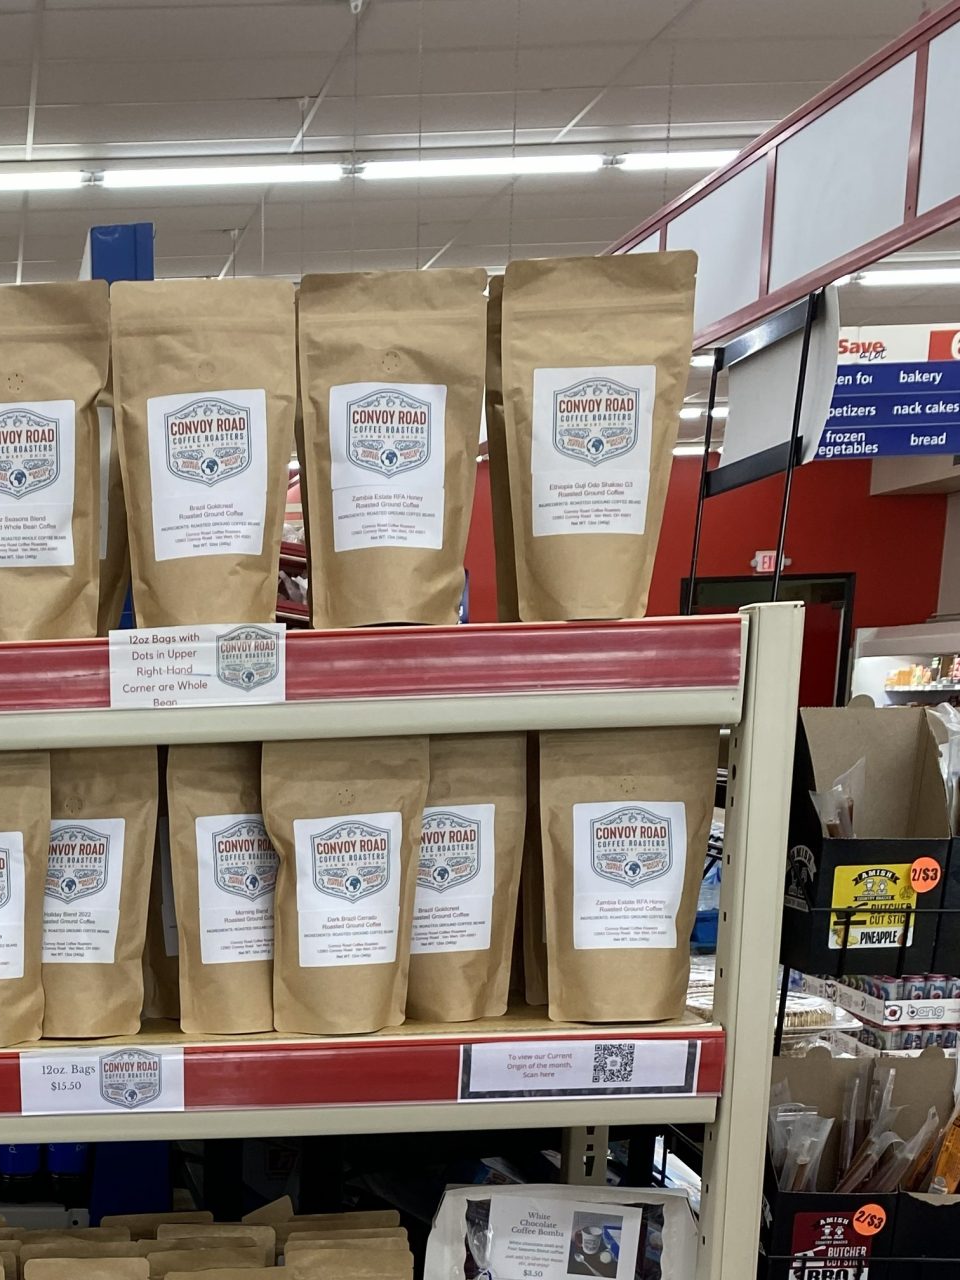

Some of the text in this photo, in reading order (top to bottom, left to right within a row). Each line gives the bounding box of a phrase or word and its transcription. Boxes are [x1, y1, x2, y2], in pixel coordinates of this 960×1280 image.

[838, 339, 884, 354] Save
[899, 370, 943, 385] bakery
[558, 398, 634, 414] CONVOY ROAD
[829, 404, 876, 417] petizers
[893, 401, 960, 415] nack cakes
[560, 412, 632, 423] COFFEE ROASTERS
[26, 428, 55, 444] ROAD
[826, 430, 866, 443] frozen
[910, 432, 947, 446] bread
[14, 444, 53, 454] ROASTERS
[818, 442, 879, 458] egetables
[129, 632, 200, 646] 12oz Bags with
[132, 649, 198, 662] Dots in Upper
[136, 664, 193, 678] Right-Hand
[122, 680, 208, 694] Corner are Whole
[153, 698, 178, 707] Bean
[596, 826, 667, 840] CONVOY ROAD
[597, 839, 665, 848] COFFEE ROASTERS
[861, 868, 892, 879] AMISH
[912, 868, 938, 882] 2/$3
[870, 914, 906, 925] CUT STIC
[860, 930, 898, 945] PINEAPPLE
[907, 1004, 945, 1020] bang
[546, 1052, 573, 1060] Current
[42, 1064, 96, 1077] 12oz. Bags
[506, 1062, 528, 1071] Origin
[528, 1062, 536, 1070] of
[50, 1080, 82, 1092] $15.50
[528, 1212, 551, 1220] White
[820, 1216, 849, 1226] AMISH
[855, 1210, 884, 1230] 2/$3
[520, 1219, 558, 1229] Chocolate
[512, 1226, 564, 1238] Coffee Bombs
[828, 1246, 867, 1258] BUTCHER
